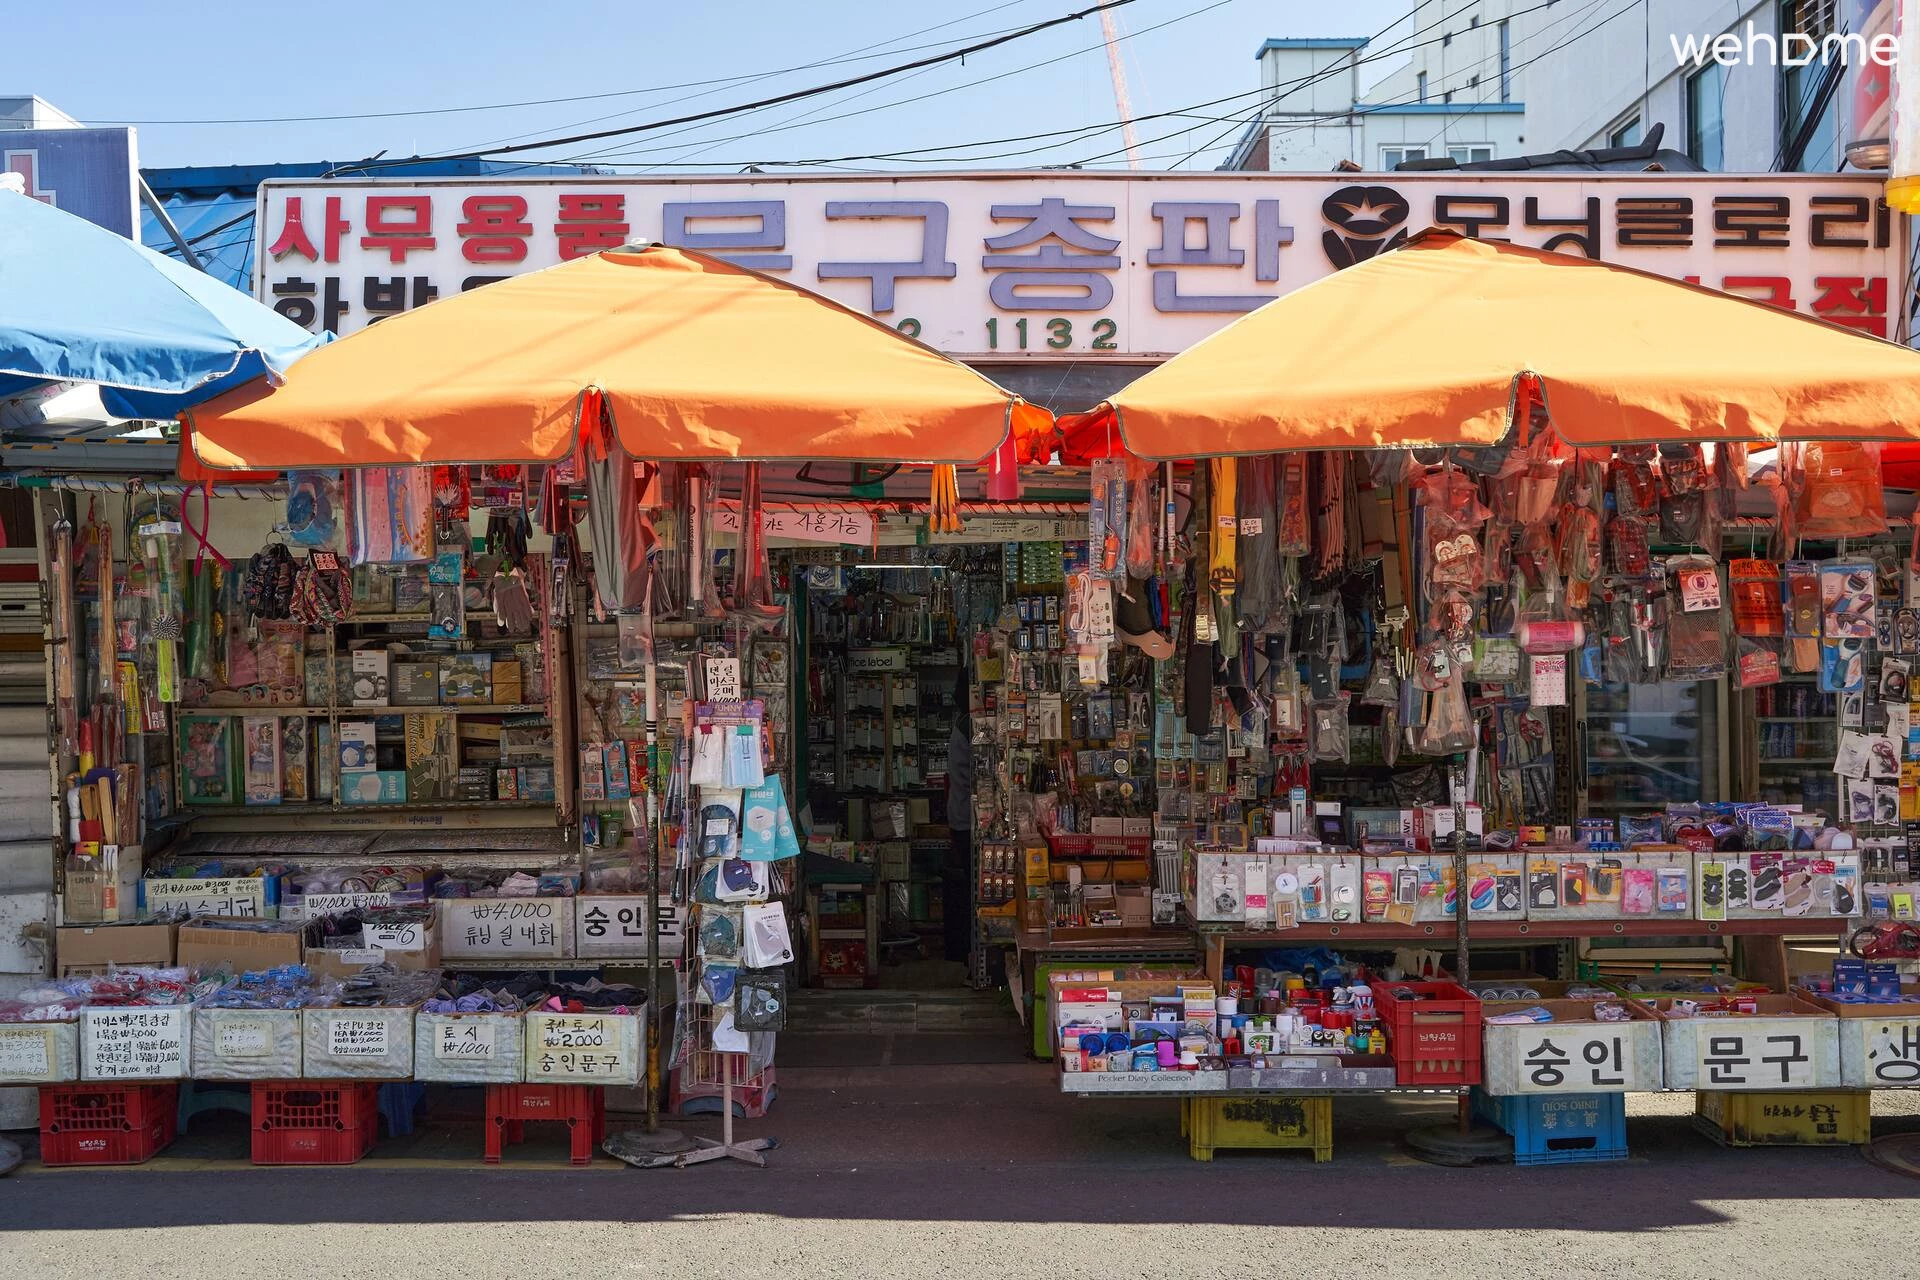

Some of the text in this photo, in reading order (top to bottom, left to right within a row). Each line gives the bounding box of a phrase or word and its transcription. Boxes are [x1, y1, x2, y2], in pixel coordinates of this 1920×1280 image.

[268, 194, 630, 263] 사무용품
[1433, 195, 1890, 259] 모닝글로리
[662, 197, 1294, 312] 문구총판
[985, 317, 1118, 350] 1132
[868, 656, 893, 667] label
[709, 677, 739, 687] 마스크
[150, 1013, 170, 1026] 장갑
[352, 1021, 364, 1030] PU
[367, 1021, 385, 1030] 장갑
[545, 1018, 604, 1034] 국산 토시
[444, 1025, 477, 1042] 토시
[537, 1053, 620, 1073] 숭인문구
[1523, 1036, 1625, 1087] 숭인
[1703, 1034, 1809, 1084] 문구
[1098, 1074, 1192, 1083] Pocket Diary Collection
[1542, 1100, 1600, 1112] JINRO SOJU
